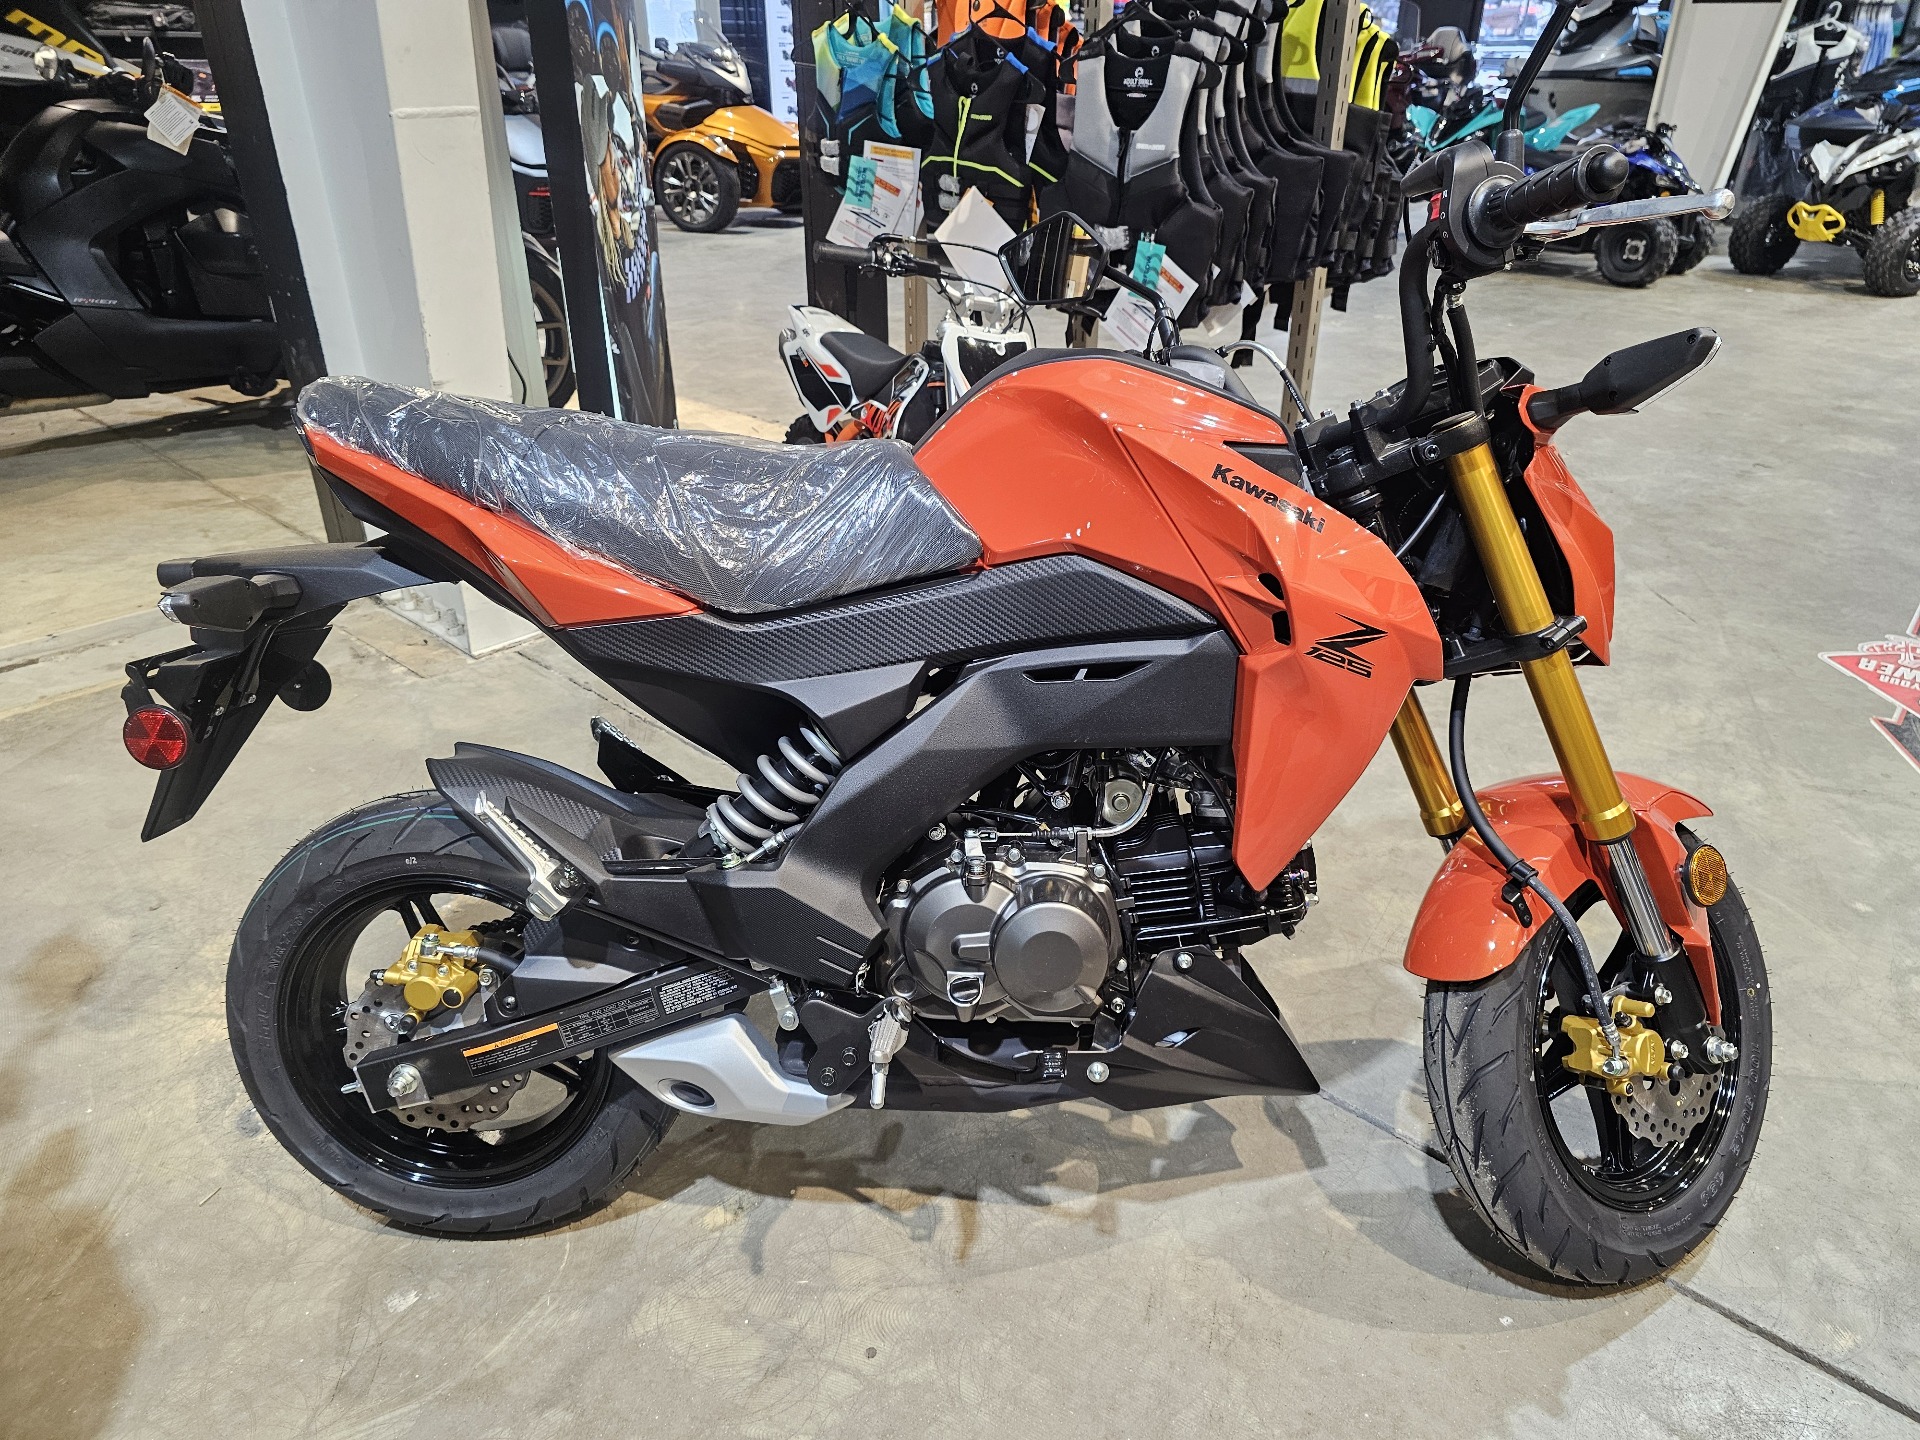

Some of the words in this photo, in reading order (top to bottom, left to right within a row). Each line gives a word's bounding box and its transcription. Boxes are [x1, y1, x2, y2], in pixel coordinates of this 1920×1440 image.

[1211, 463, 1326, 534] Kawasaki
[1303, 646, 1373, 679] 125
[1314, 612, 1389, 667] Z
